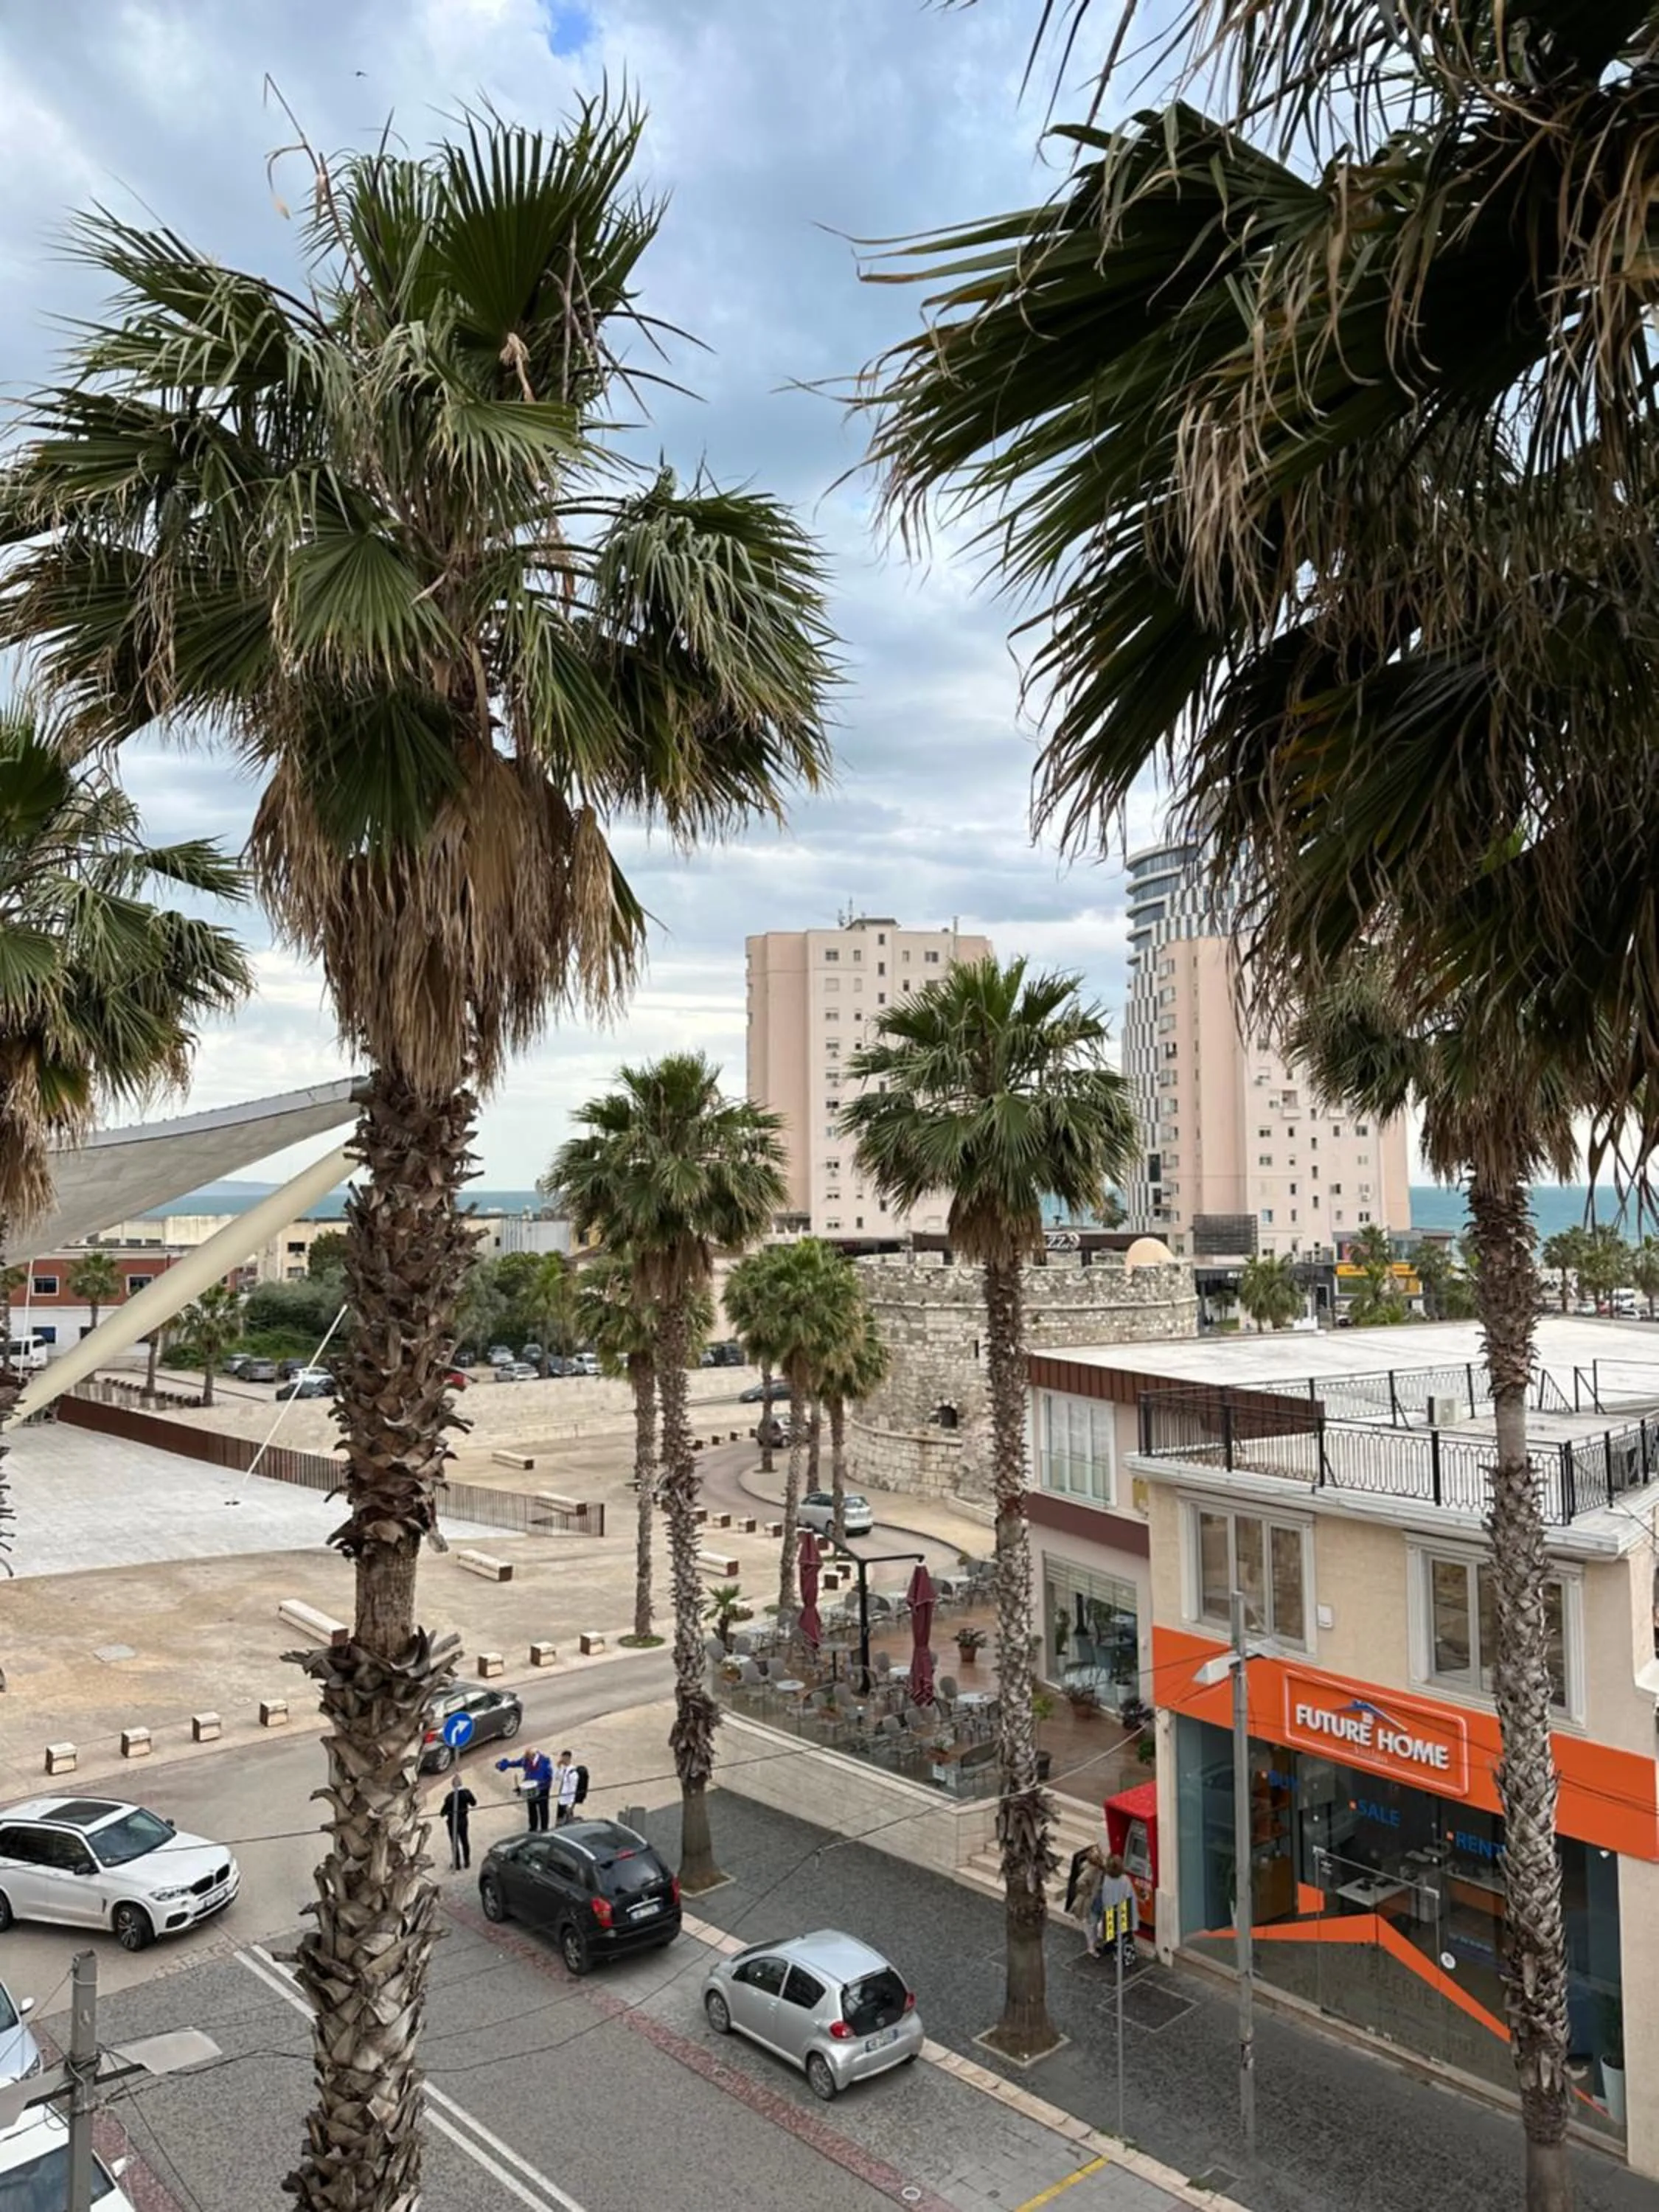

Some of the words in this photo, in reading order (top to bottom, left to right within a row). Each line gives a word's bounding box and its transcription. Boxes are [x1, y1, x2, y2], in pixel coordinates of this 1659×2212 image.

[1295, 1703, 1372, 1746] FUTURE
[1377, 1728, 1450, 1770] HOME
[1357, 1799, 1400, 1828] SALE
